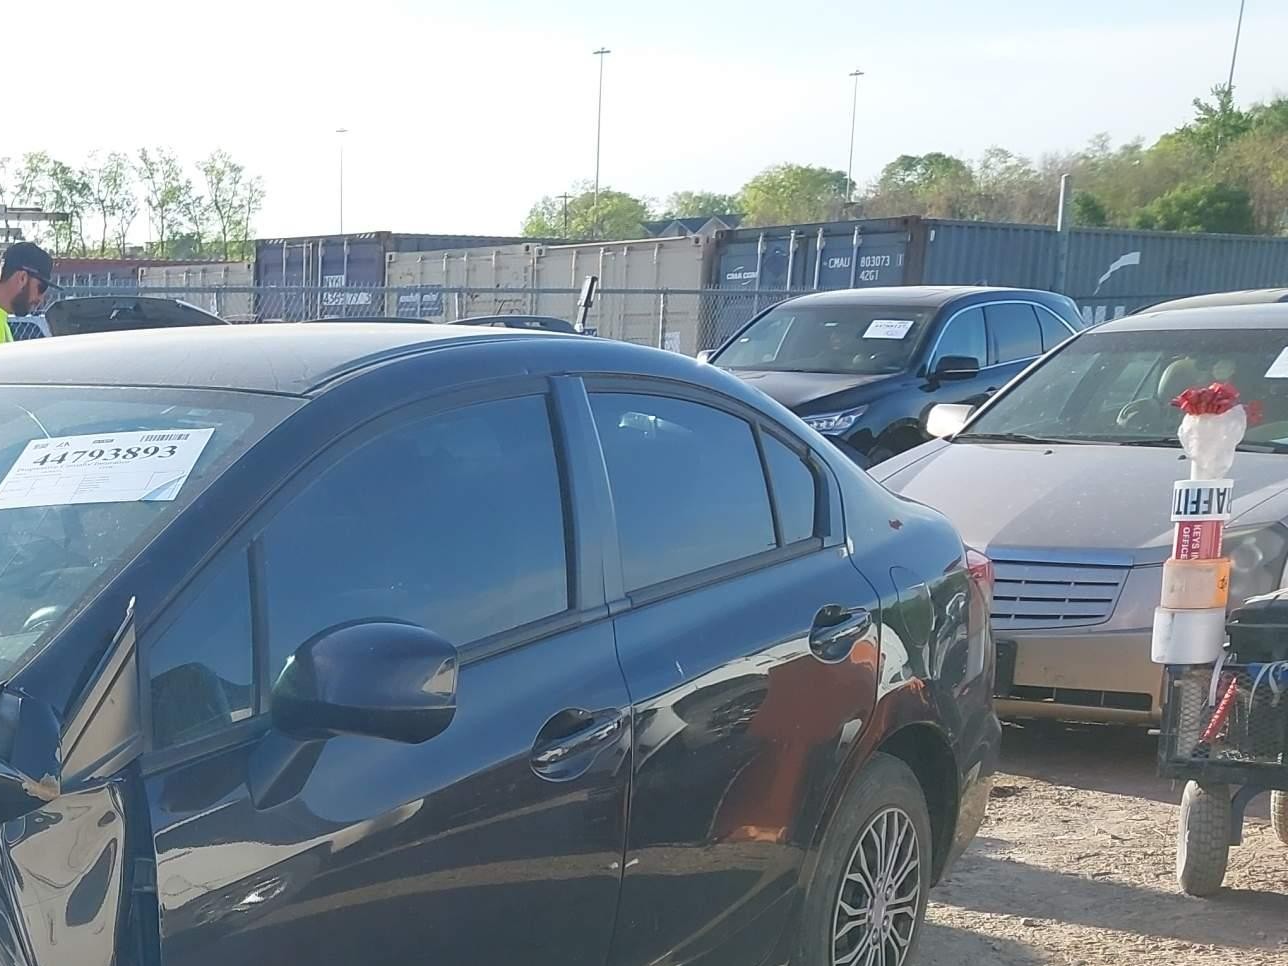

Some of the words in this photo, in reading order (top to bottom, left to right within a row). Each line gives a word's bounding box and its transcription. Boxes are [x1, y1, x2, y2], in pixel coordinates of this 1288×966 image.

[33, 445, 178, 466] 44793893
[1180, 527, 1190, 560] OFFICE
[1192, 524, 1201, 549] KEYS
